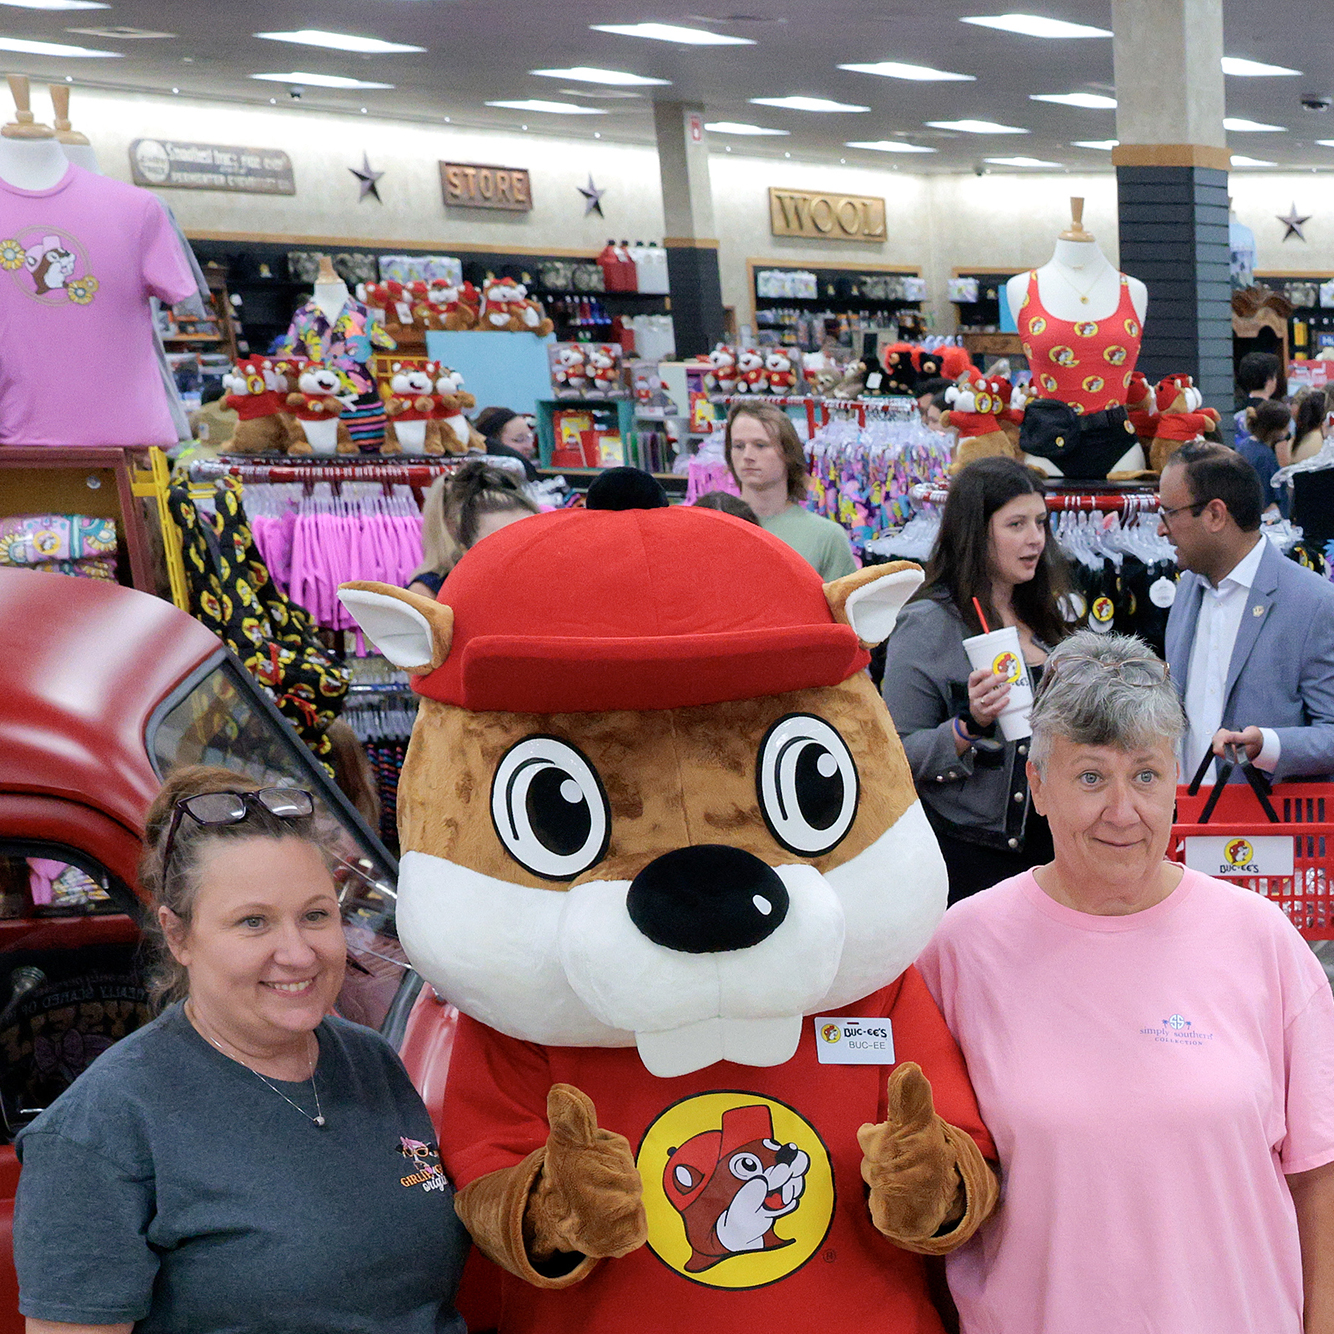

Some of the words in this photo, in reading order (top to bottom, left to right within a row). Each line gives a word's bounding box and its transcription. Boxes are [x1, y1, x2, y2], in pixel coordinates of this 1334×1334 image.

[446, 166, 527, 203] STORE
[775, 193, 884, 237] WOOL
[1219, 864, 1259, 873] BUC-EE'S
[843, 1027, 888, 1039] BUC-EE'S
[1140, 1026, 1169, 1037] simply
[849, 1041, 886, 1050] BUC-EE
[1155, 1037, 1203, 1045] COLLECTION
